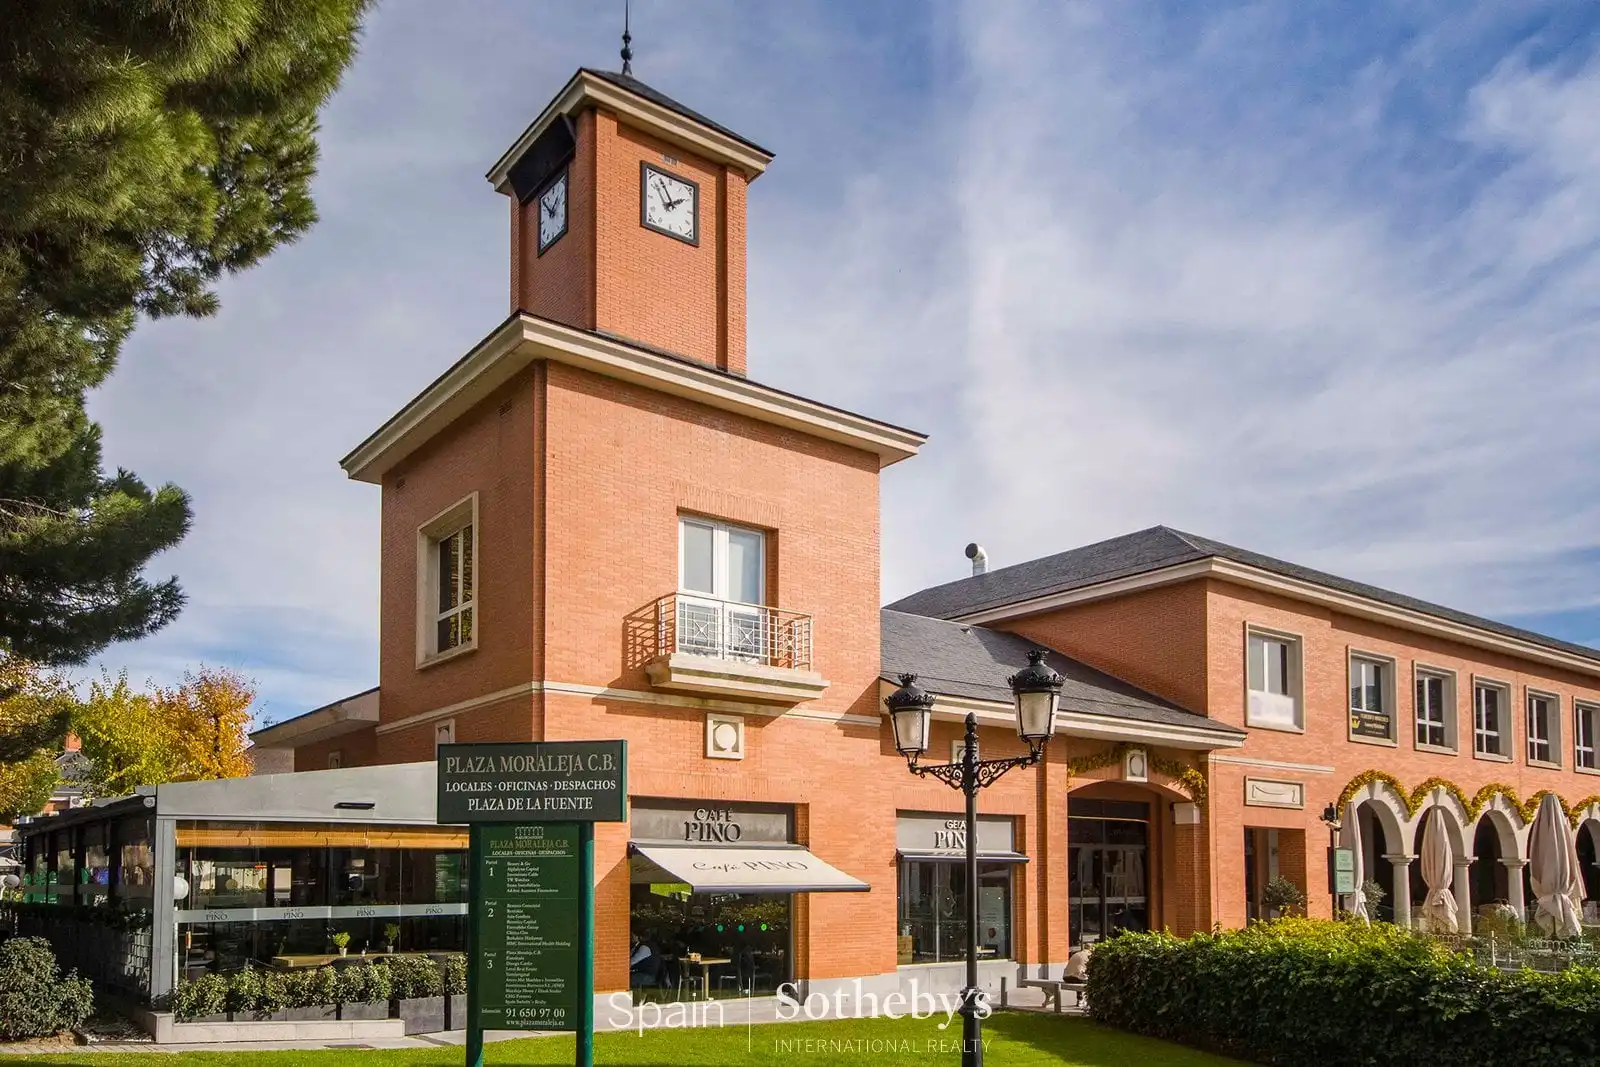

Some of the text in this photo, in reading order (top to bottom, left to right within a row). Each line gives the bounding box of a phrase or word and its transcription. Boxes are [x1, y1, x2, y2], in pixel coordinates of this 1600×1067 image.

[446, 754, 617, 777] PLAZA MORALEJA C.B.
[445, 779, 617, 793] LOCALES OFICINAS DESPACHOS
[468, 796, 593, 811] PLAZA DE LA FUENTE
[694, 807, 733, 822] CAFÉ
[684, 821, 741, 843] PINO
[934, 830, 979, 849] PIN
[490, 840, 514, 849] PLAZA
[515, 840, 554, 851] MORALEJA
[489, 867, 494, 877] 1
[692, 860, 809, 873] Café PINO
[205, 913, 228, 921] PINO
[283, 911, 304, 919] PINO
[356, 909, 376, 917] PINO
[487, 907, 494, 918] 2
[486, 959, 493, 969] 3
[505, 1008, 566, 1018] 91 650 97 00
[506, 1019, 565, 1028] www.plazamoraleja.es
